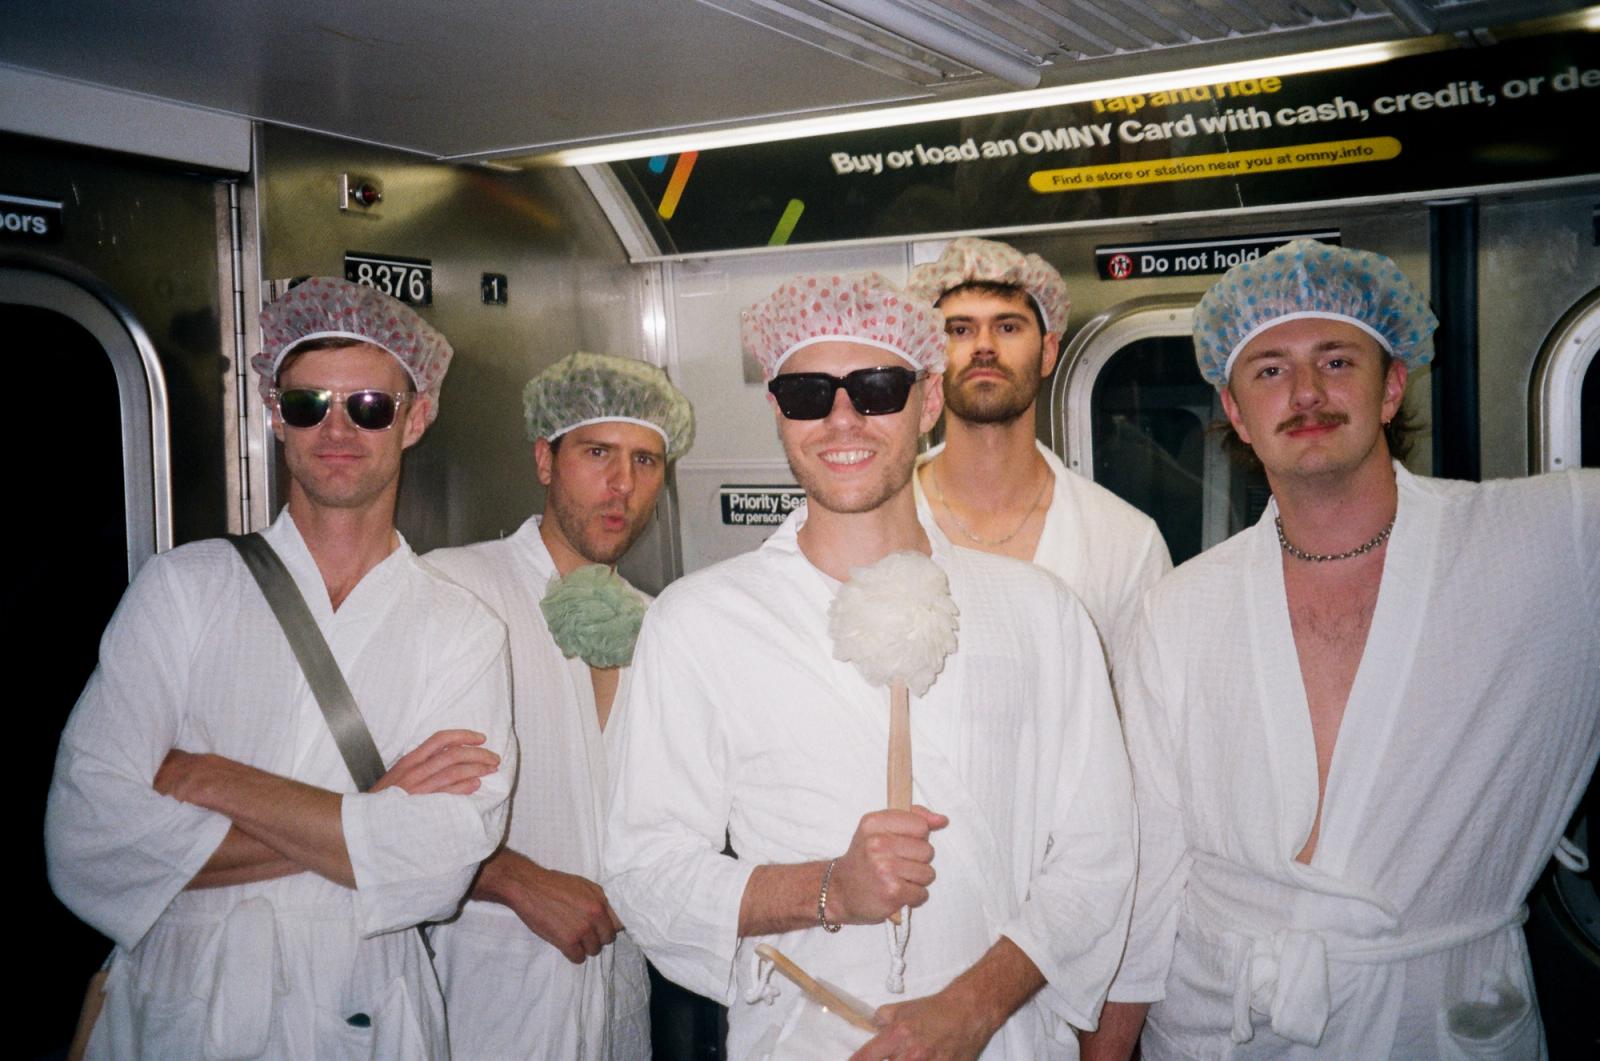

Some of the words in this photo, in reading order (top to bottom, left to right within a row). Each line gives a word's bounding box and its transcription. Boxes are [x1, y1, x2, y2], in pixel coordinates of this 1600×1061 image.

[831, 151, 883, 175] Buy
[887, 151, 914, 169] or
[916, 138, 980, 165] load
[981, 138, 1018, 158] an
[1018, 122, 1113, 154] OMNY
[1119, 113, 1198, 144] Card
[1200, 104, 1273, 134] with
[1274, 96, 1369, 124] cash,
[1373, 81, 1497, 114] credit,
[1502, 76, 1545, 98] or
[1052, 174, 1081, 185] Find
[1096, 170, 1133, 182] store
[1136, 169, 1151, 178] or
[1154, 163, 1205, 176] station
[1208, 160, 1240, 170] near
[1245, 157, 1273, 169] you
[1277, 153, 1292, 164] at
[1295, 145, 1374, 162] omny.info
[1141, 255, 1169, 273] Do
[1174, 253, 1208, 271] not
[1213, 248, 1260, 267] hold
[358, 263, 424, 300] 8376
[491, 278, 498, 300] 1
[729, 494, 779, 513] Priority
[730, 512, 744, 522] for
[746, 512, 787, 525] persons
